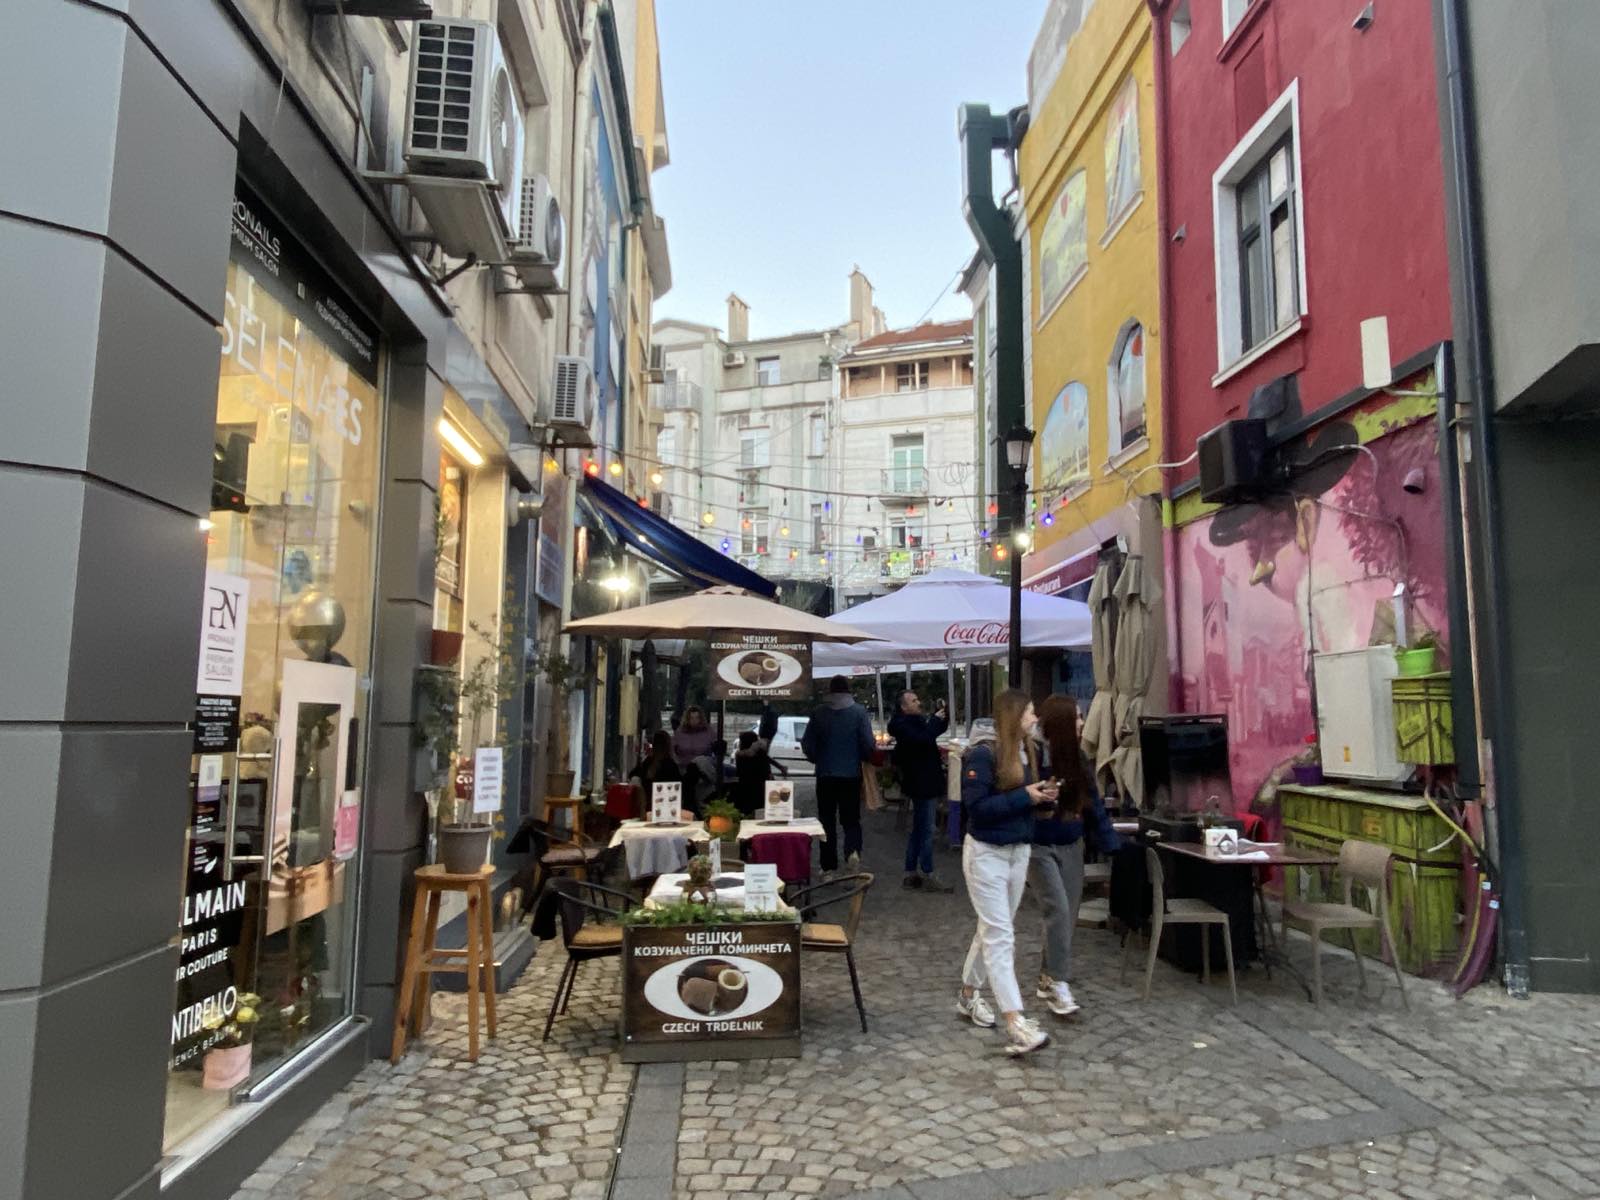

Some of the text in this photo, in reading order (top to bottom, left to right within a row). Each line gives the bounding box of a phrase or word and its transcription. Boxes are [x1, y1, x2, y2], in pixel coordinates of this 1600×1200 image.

[254, 246, 279, 276] SALON
[742, 635, 778, 644] ЧЕШКИ
[728, 689, 752, 697] CZECH
[178, 880, 246, 928] LMAIN
[181, 928, 217, 955] PARIS
[685, 931, 743, 945] ЧЕШКИ
[634, 942, 792, 957] КОЗУНАЧЕНИ КОМИНЧЕТА
[187, 947, 229, 976] COUTURE
[661, 1020, 764, 1034] CZECH TRDELNIK
